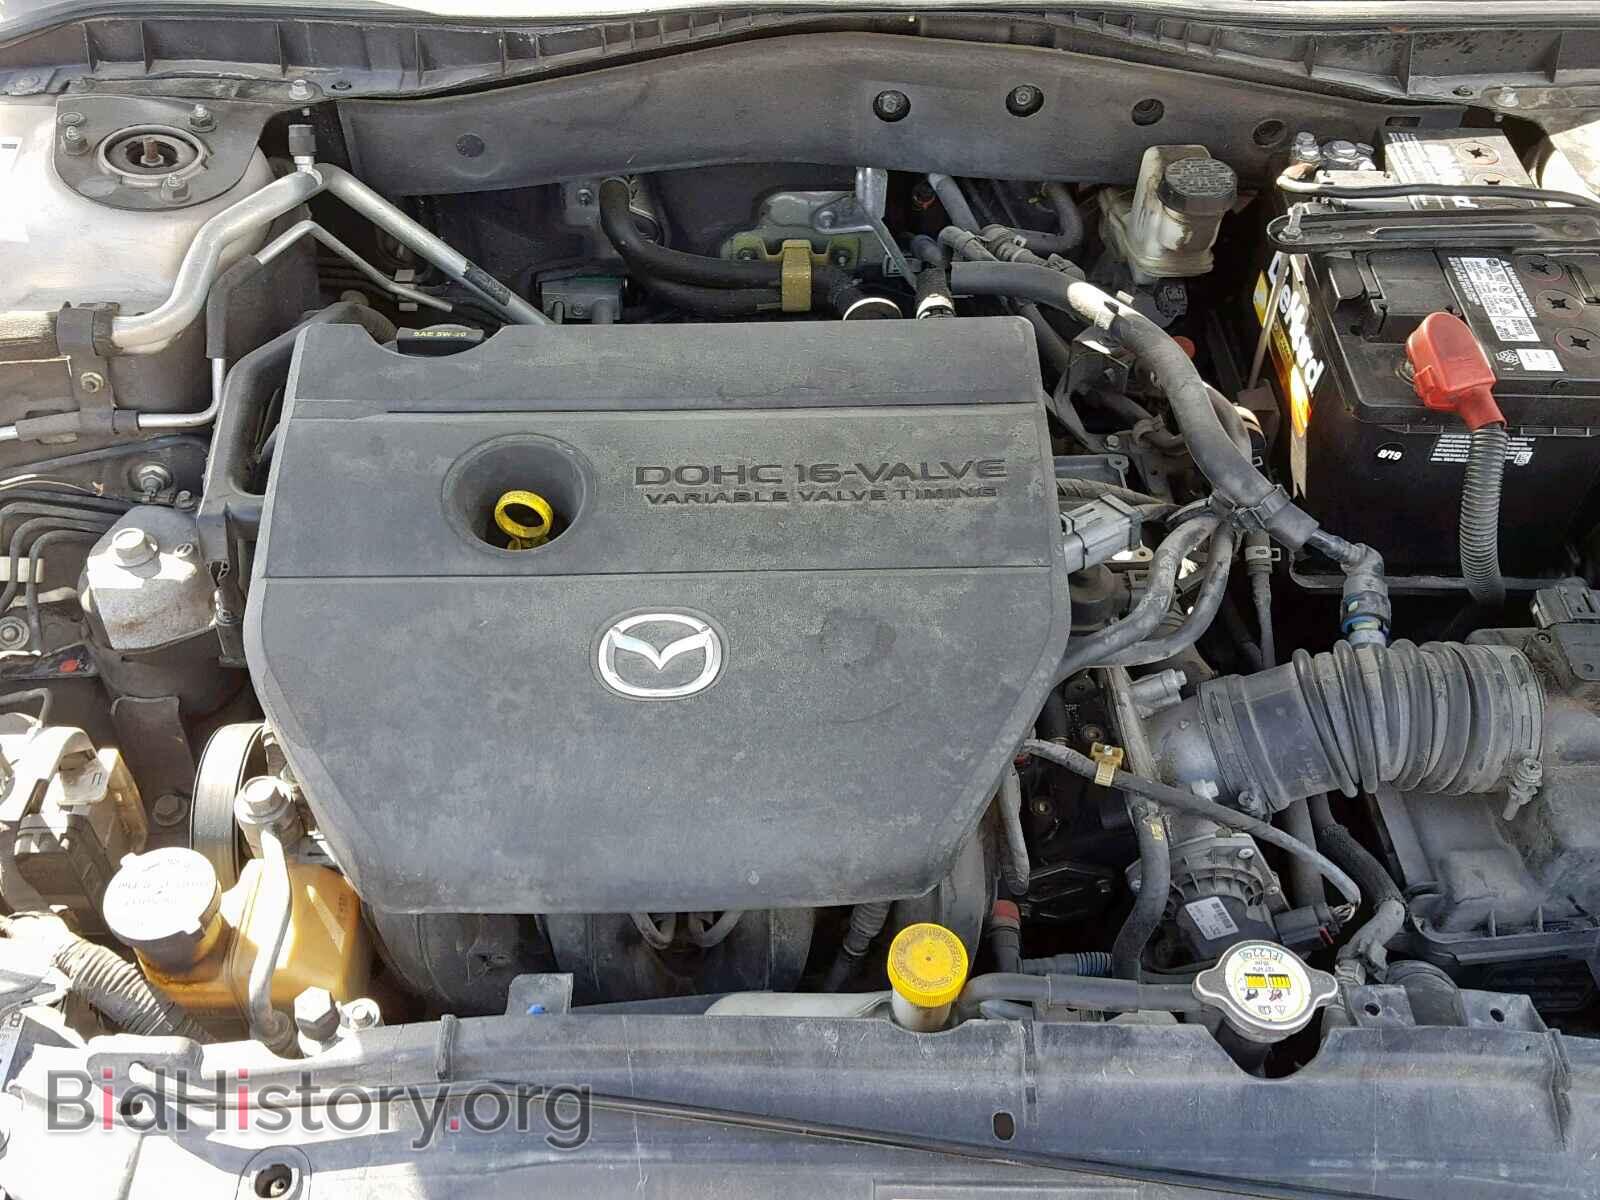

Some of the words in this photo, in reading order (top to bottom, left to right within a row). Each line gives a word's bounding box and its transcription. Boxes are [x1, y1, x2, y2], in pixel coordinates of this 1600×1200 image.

[1377, 449, 1402, 461] 8/19
[635, 465, 785, 486] DOHC
[797, 459, 1008, 484] 16-VALVE
[645, 491, 790, 505] VARIABLE
[800, 487, 888, 502] VALVE
[897, 485, 998, 500] TIMING
